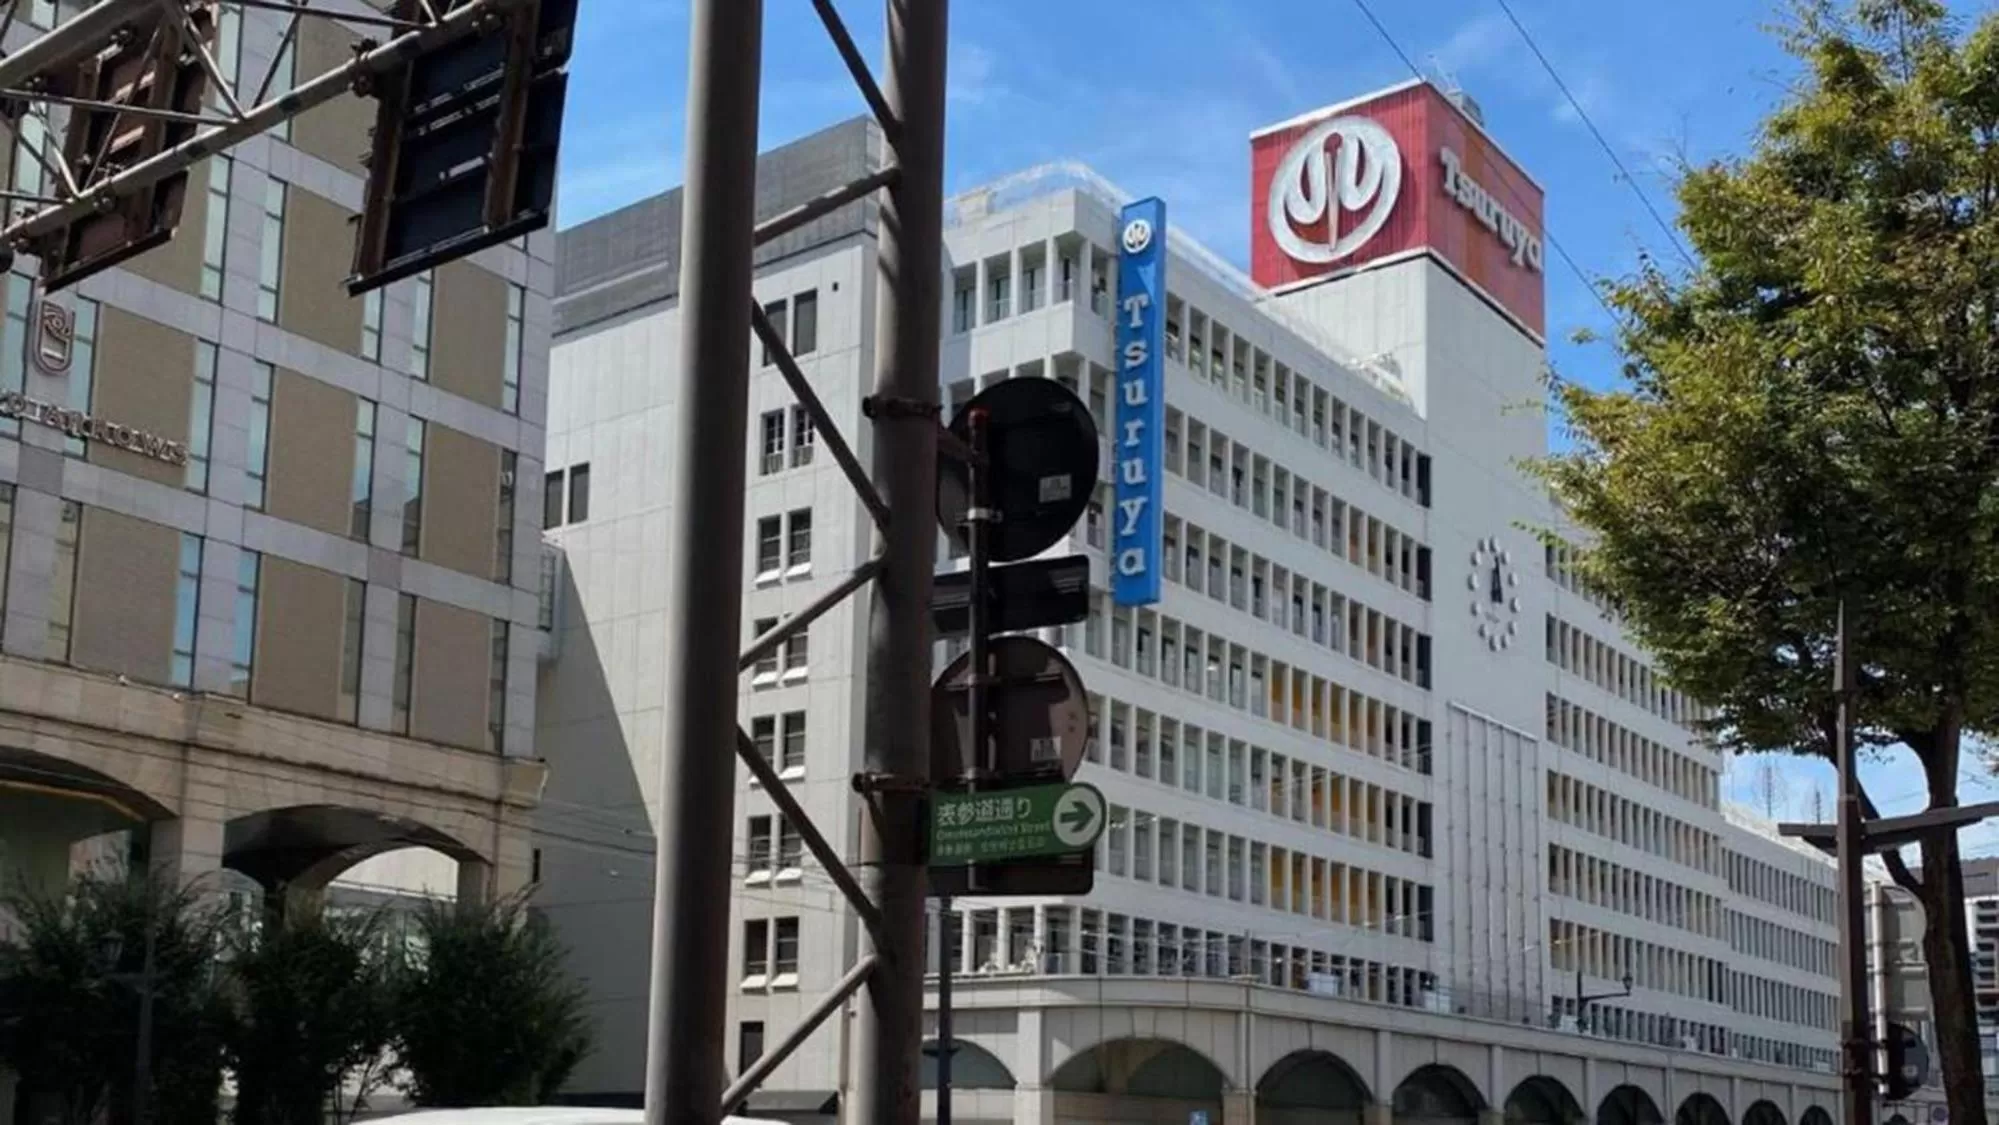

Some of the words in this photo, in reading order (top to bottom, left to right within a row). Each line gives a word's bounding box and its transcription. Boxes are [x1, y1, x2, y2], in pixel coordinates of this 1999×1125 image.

[1440, 147, 1543, 272] Tsuruya
[1118, 298, 1150, 576] Tsuruya
[936, 797, 1032, 826] 表参道通り
